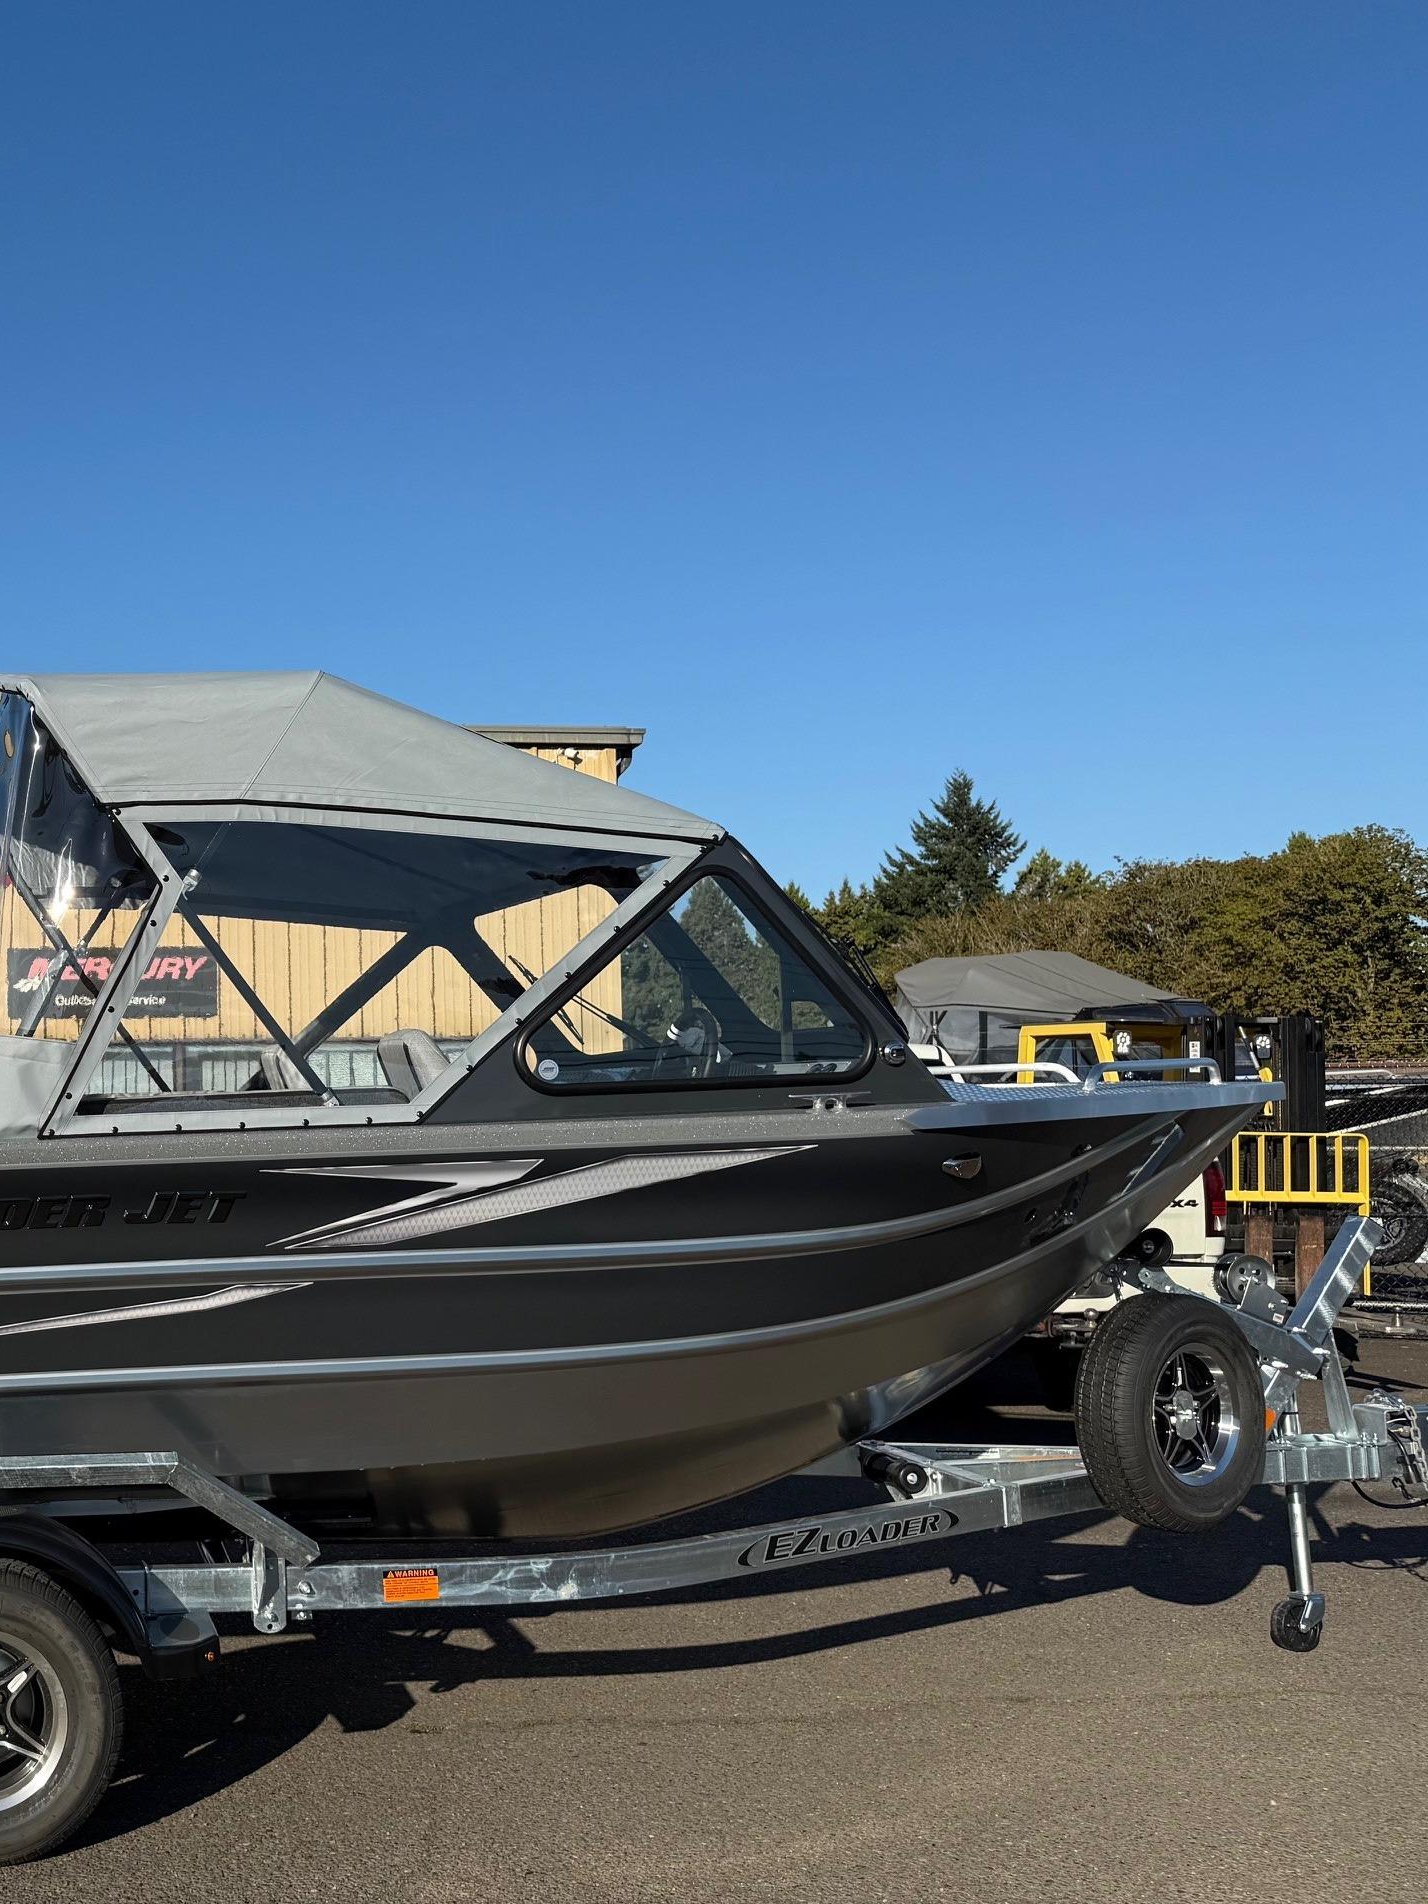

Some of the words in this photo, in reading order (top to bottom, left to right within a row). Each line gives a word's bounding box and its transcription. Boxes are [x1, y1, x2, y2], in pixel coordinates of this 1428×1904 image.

[123, 1191, 248, 1225] JET
[1170, 1199, 1199, 1208] X4
[394, 1569, 435, 1578] WARNING
